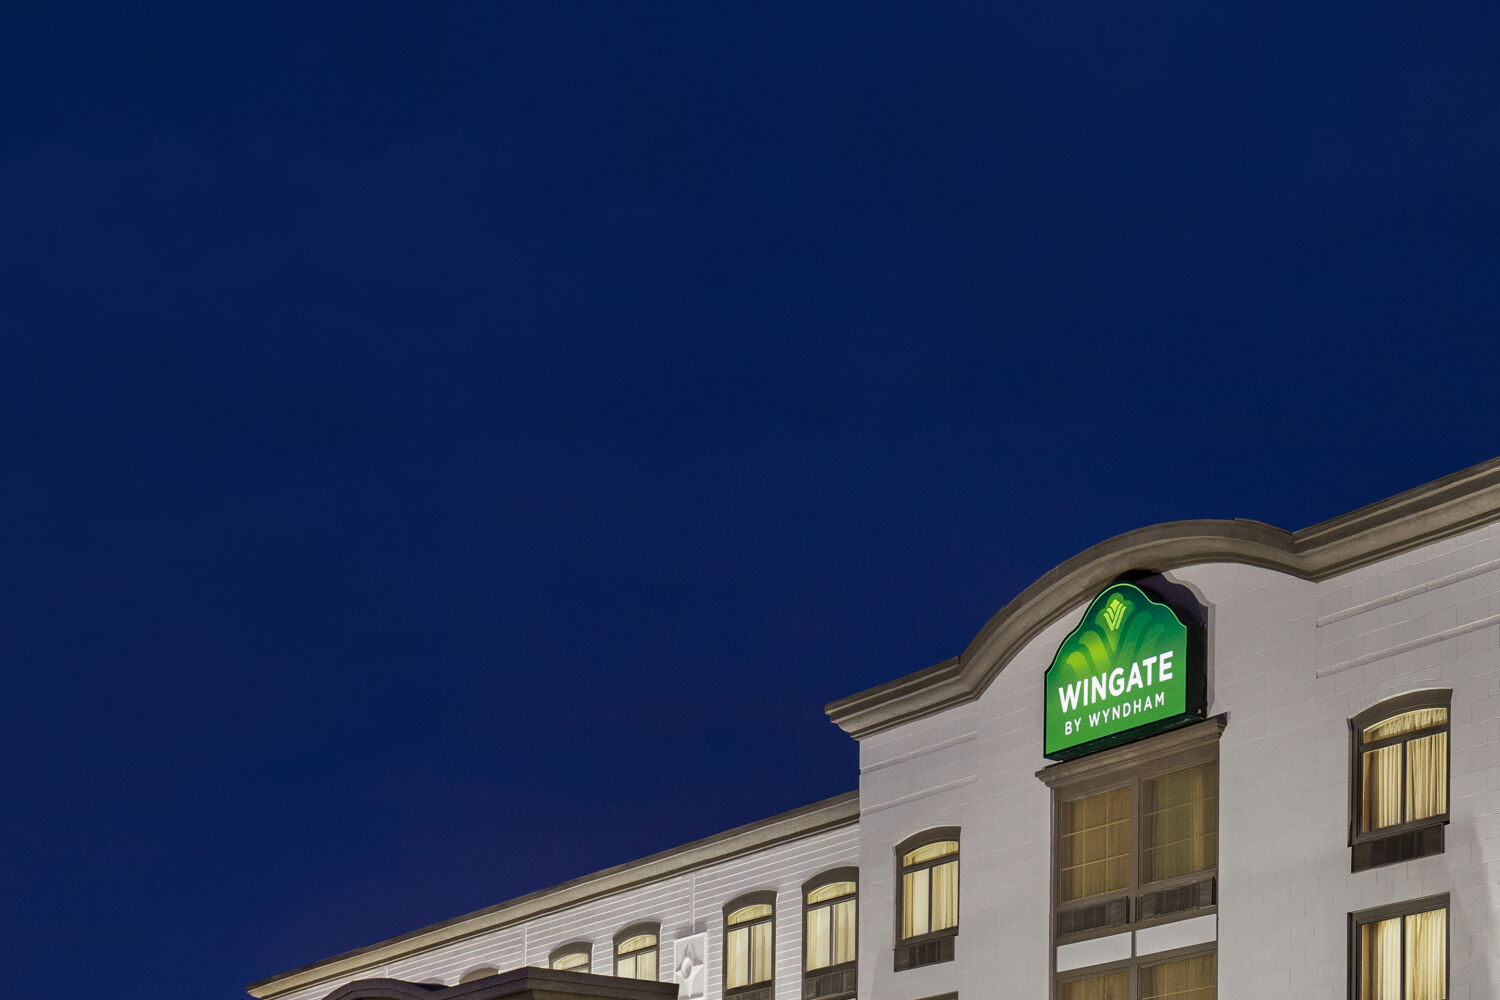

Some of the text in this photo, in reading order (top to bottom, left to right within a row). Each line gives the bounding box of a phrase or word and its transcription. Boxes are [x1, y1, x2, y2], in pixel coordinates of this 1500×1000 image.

[1058, 651, 1174, 713] WINGATE
[1064, 691, 1165, 736] BY WYNDHAM
